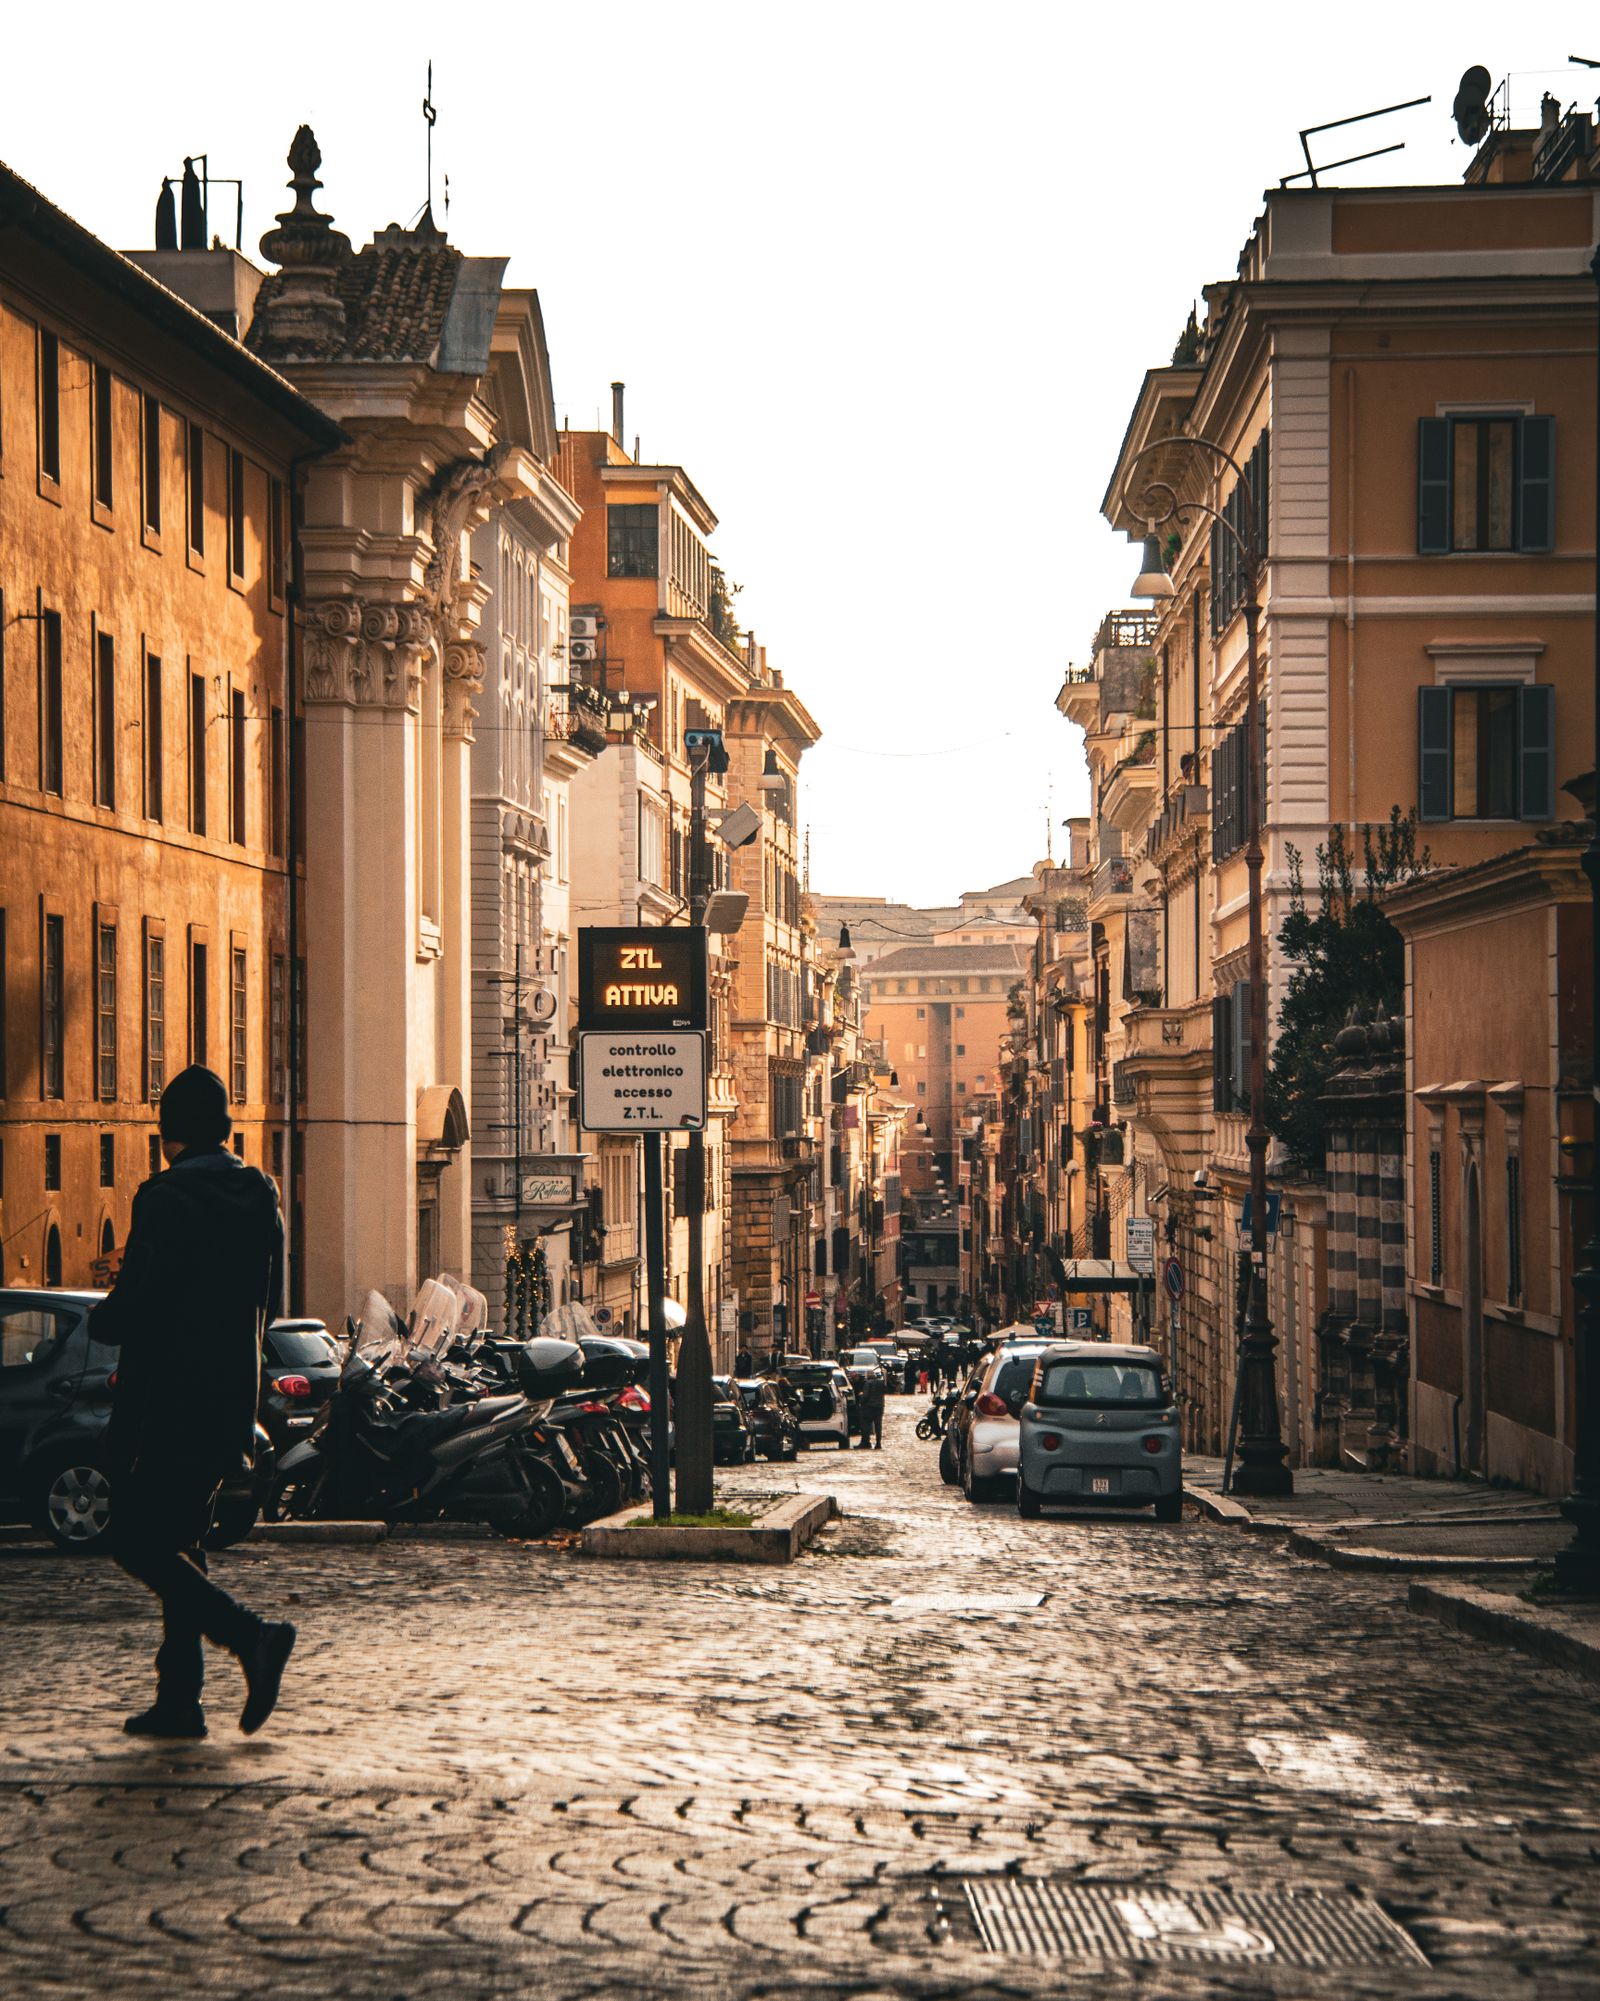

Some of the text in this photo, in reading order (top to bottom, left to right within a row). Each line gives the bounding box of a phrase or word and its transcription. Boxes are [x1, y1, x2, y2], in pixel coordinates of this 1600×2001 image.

[620, 948, 662, 969] ZTL
[605, 985, 678, 1006] ATTIVA
[526, 946, 558, 1154] HOTEL
[609, 1044, 677, 1056] controllo
[602, 1065, 684, 1078] elettronico
[614, 1087, 672, 1098] accesso
[623, 1106, 663, 1119] Z.T.L.
